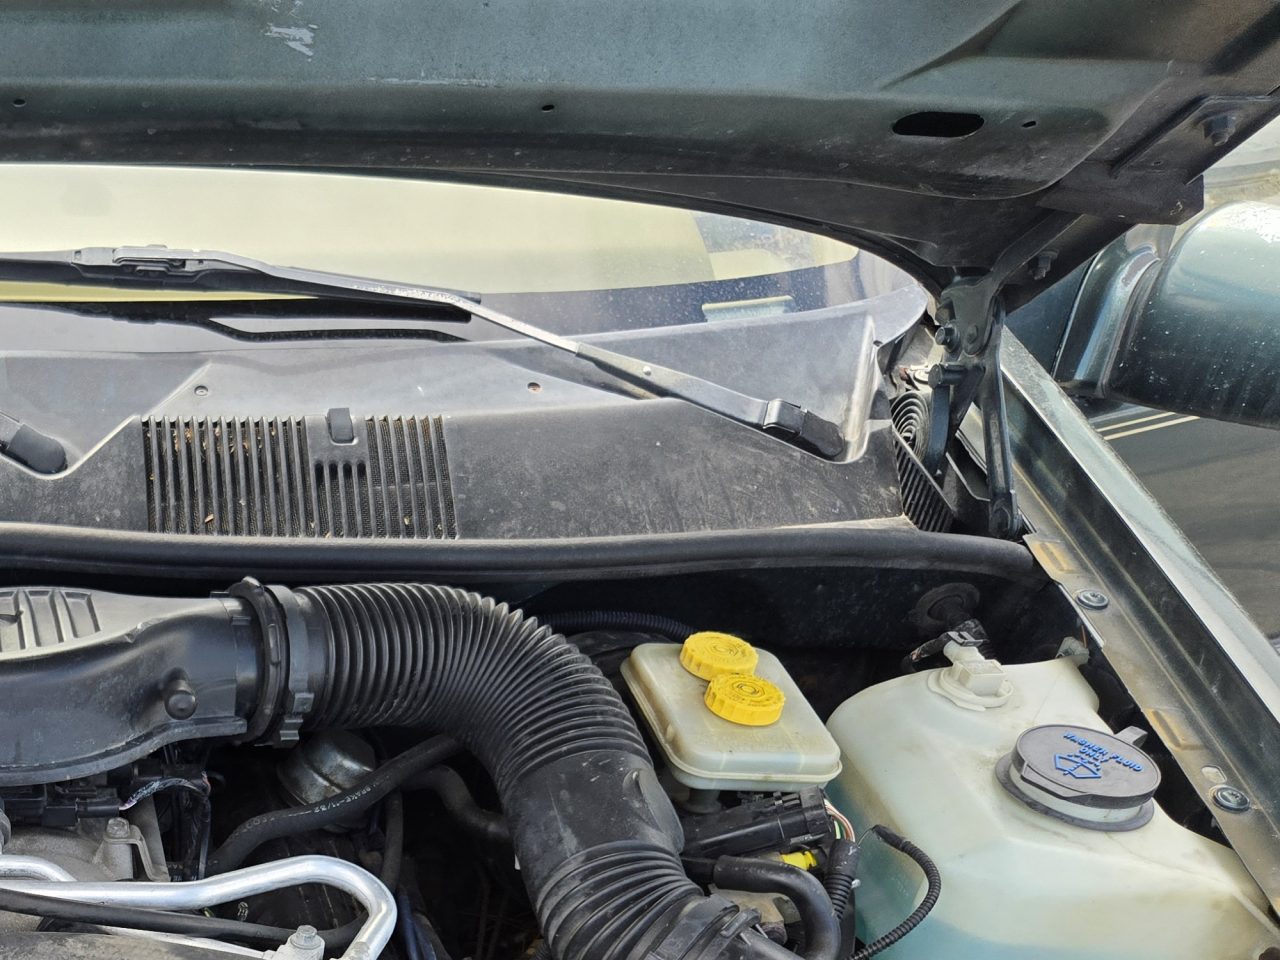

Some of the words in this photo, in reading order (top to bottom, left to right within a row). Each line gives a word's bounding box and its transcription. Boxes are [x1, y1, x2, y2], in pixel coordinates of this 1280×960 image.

[1063, 732, 1108, 759] WASHER
[1111, 753, 1144, 772] FLUID
[1079, 747, 1110, 763] ONLY
